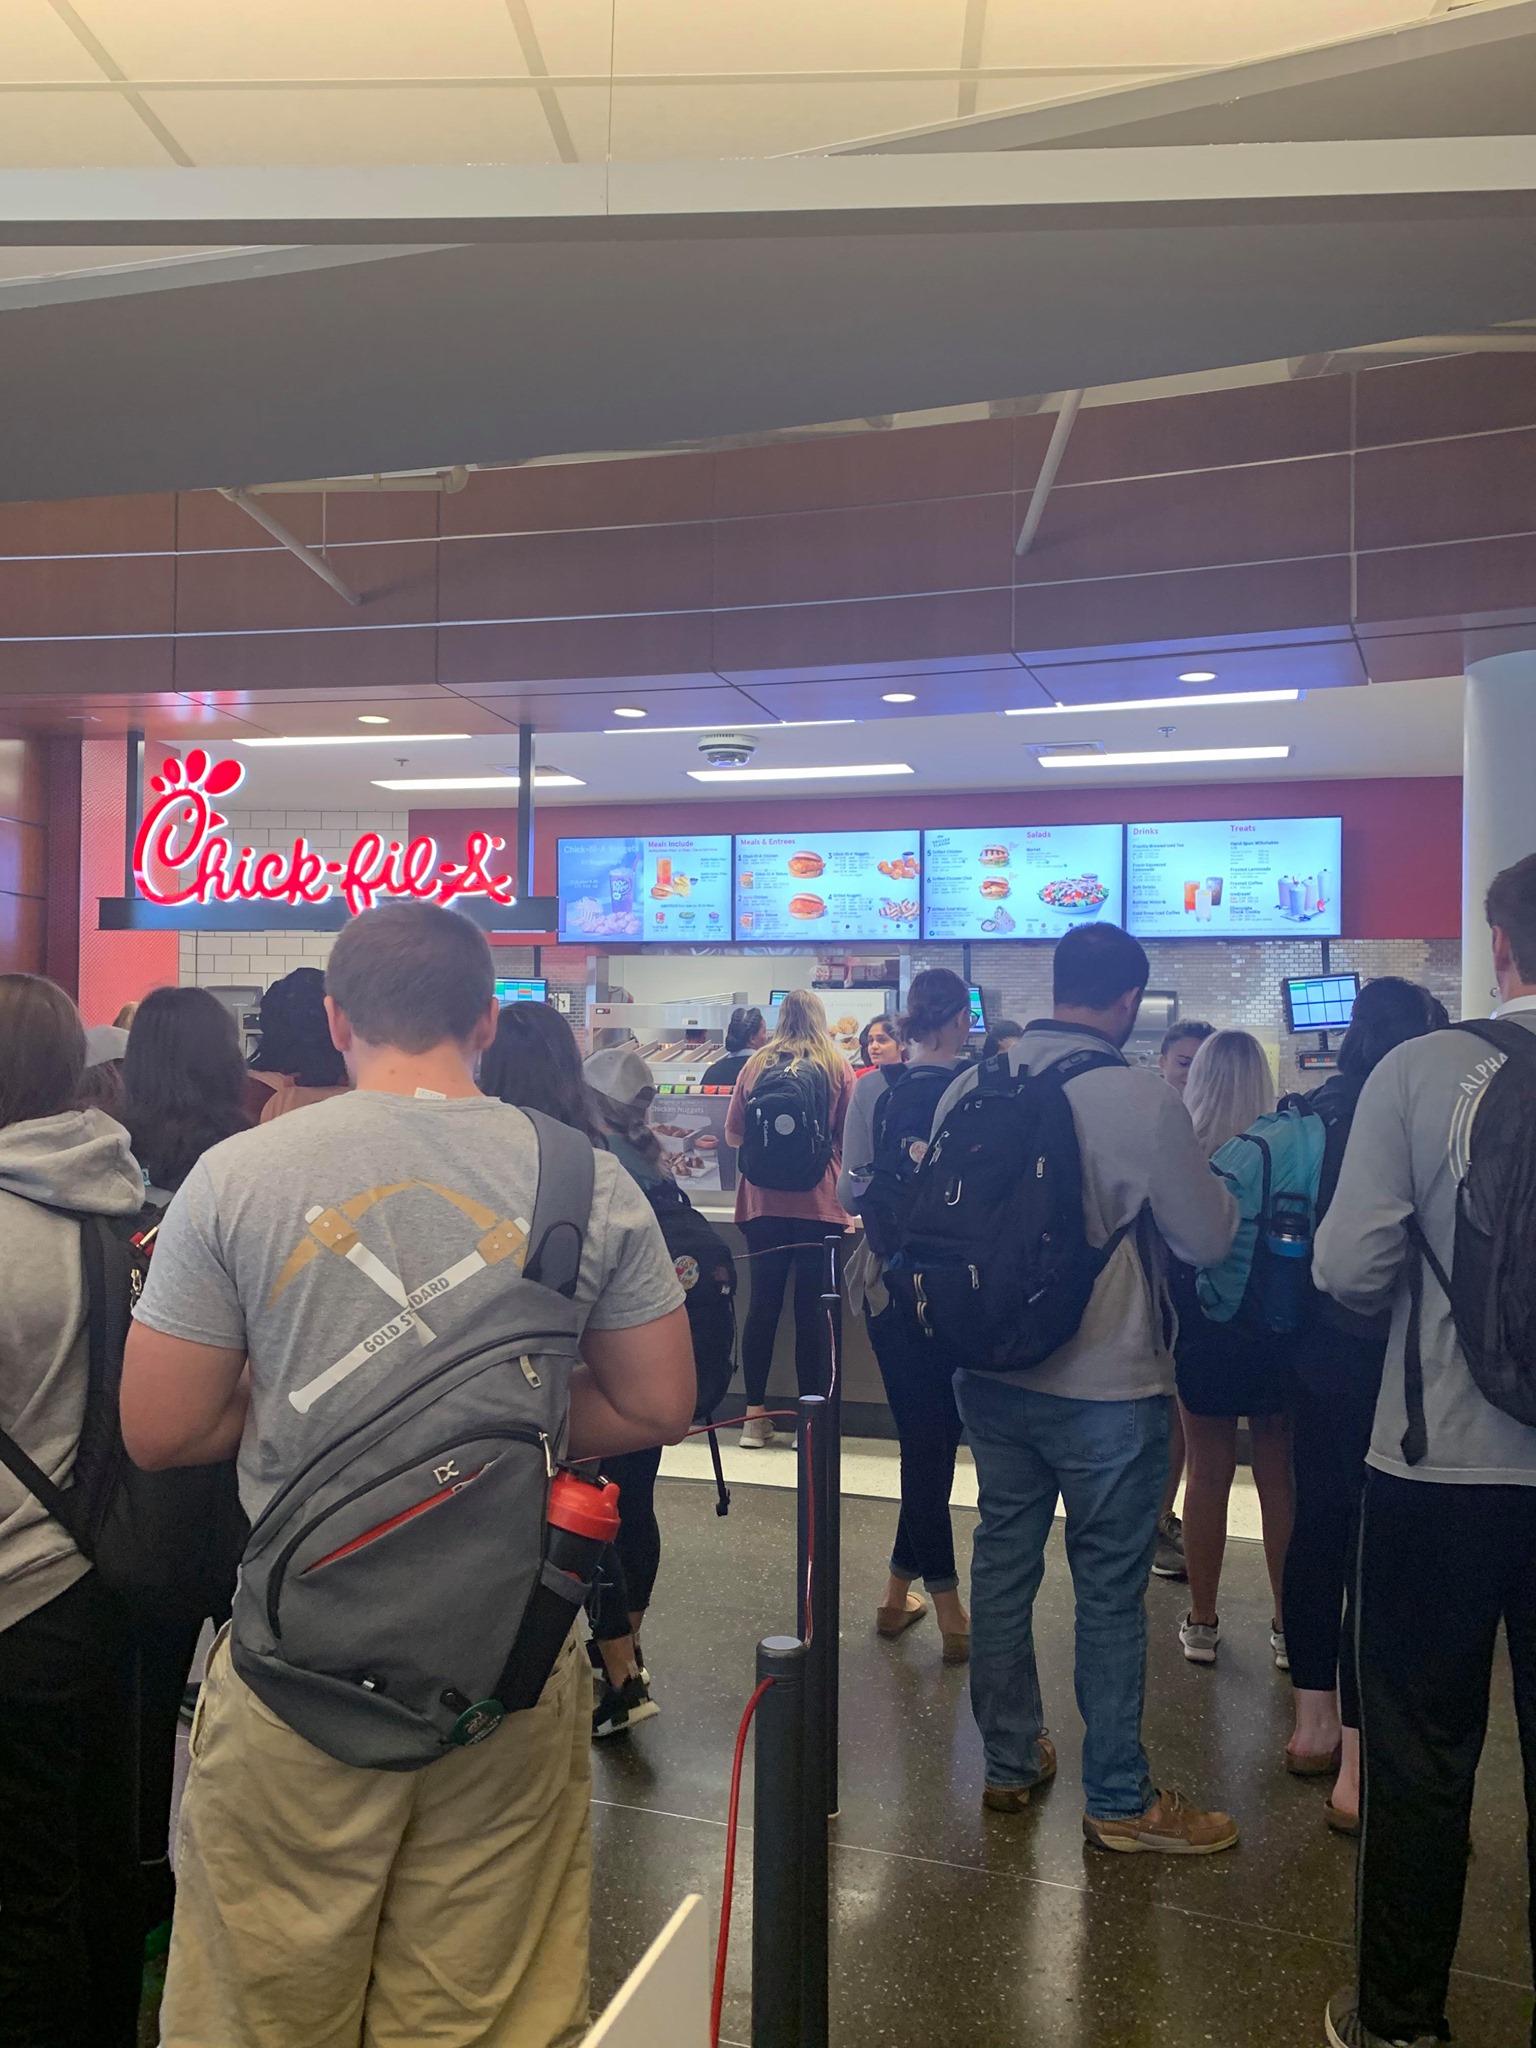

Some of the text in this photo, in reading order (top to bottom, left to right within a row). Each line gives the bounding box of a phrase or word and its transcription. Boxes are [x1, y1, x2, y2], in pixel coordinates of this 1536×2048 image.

[1133, 827, 1159, 835] Drinks
[1230, 824, 1256, 832] Treats
[133, 748, 517, 917] Chick-fil-A
[1027, 830, 1051, 838] Salads
[926, 849, 932, 857] 5
[1459, 1052, 1509, 1096] ALPHA
[363, 1277, 450, 1353] GOLD STDARD
